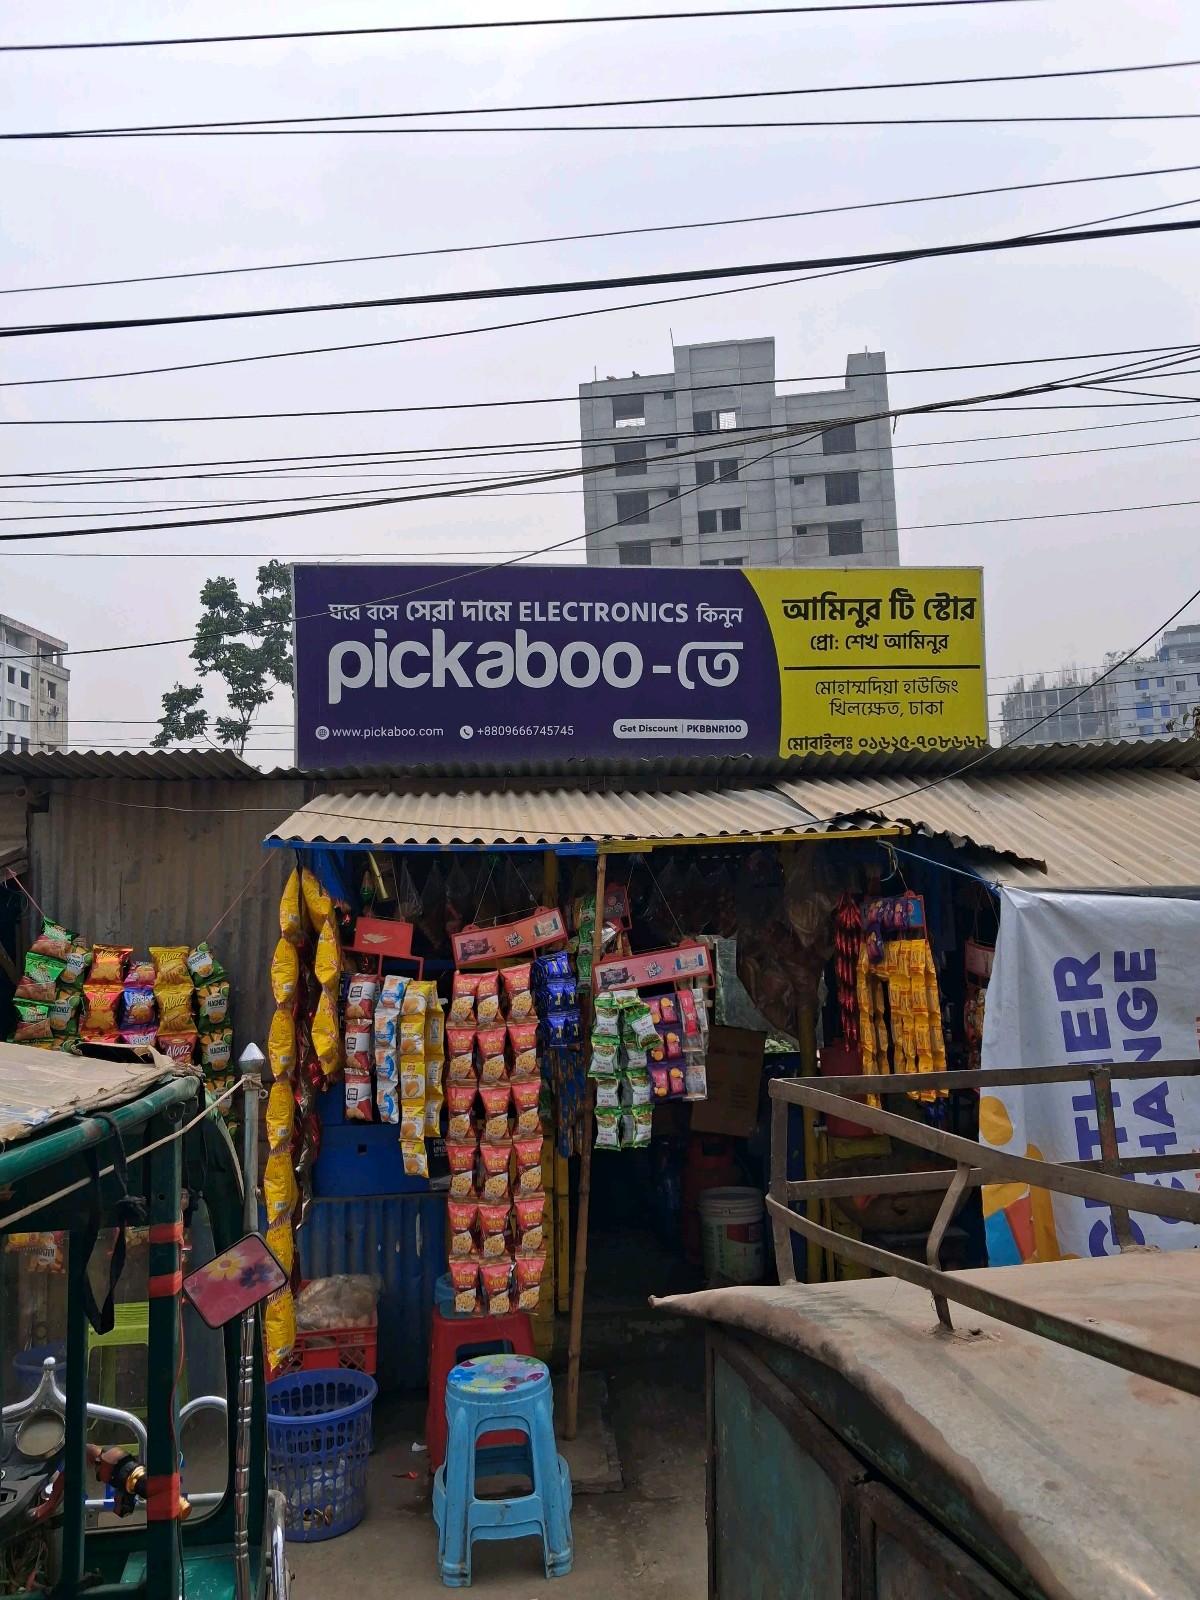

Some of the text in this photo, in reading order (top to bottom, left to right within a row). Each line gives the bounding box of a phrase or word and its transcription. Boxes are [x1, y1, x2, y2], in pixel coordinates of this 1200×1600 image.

[327, 599, 744, 628] ঘরে বসে সেরা দামে ELECTRONICS কিনুন
[781, 587, 977, 628] আমিনুর টি স্টোর
[845, 633, 879, 650] শেখ
[883, 629, 950, 654] আমিনুর
[815, 676, 959, 696] মোহাম্মদিয়া হাউজিং
[908, 700, 944, 716] ঢাকা
[332, 725, 445, 738] www.pickaboo.com
[476, 725, 575, 737] +8809666745745
[619, 724, 742, 734] Get Discount PKBBNR100
